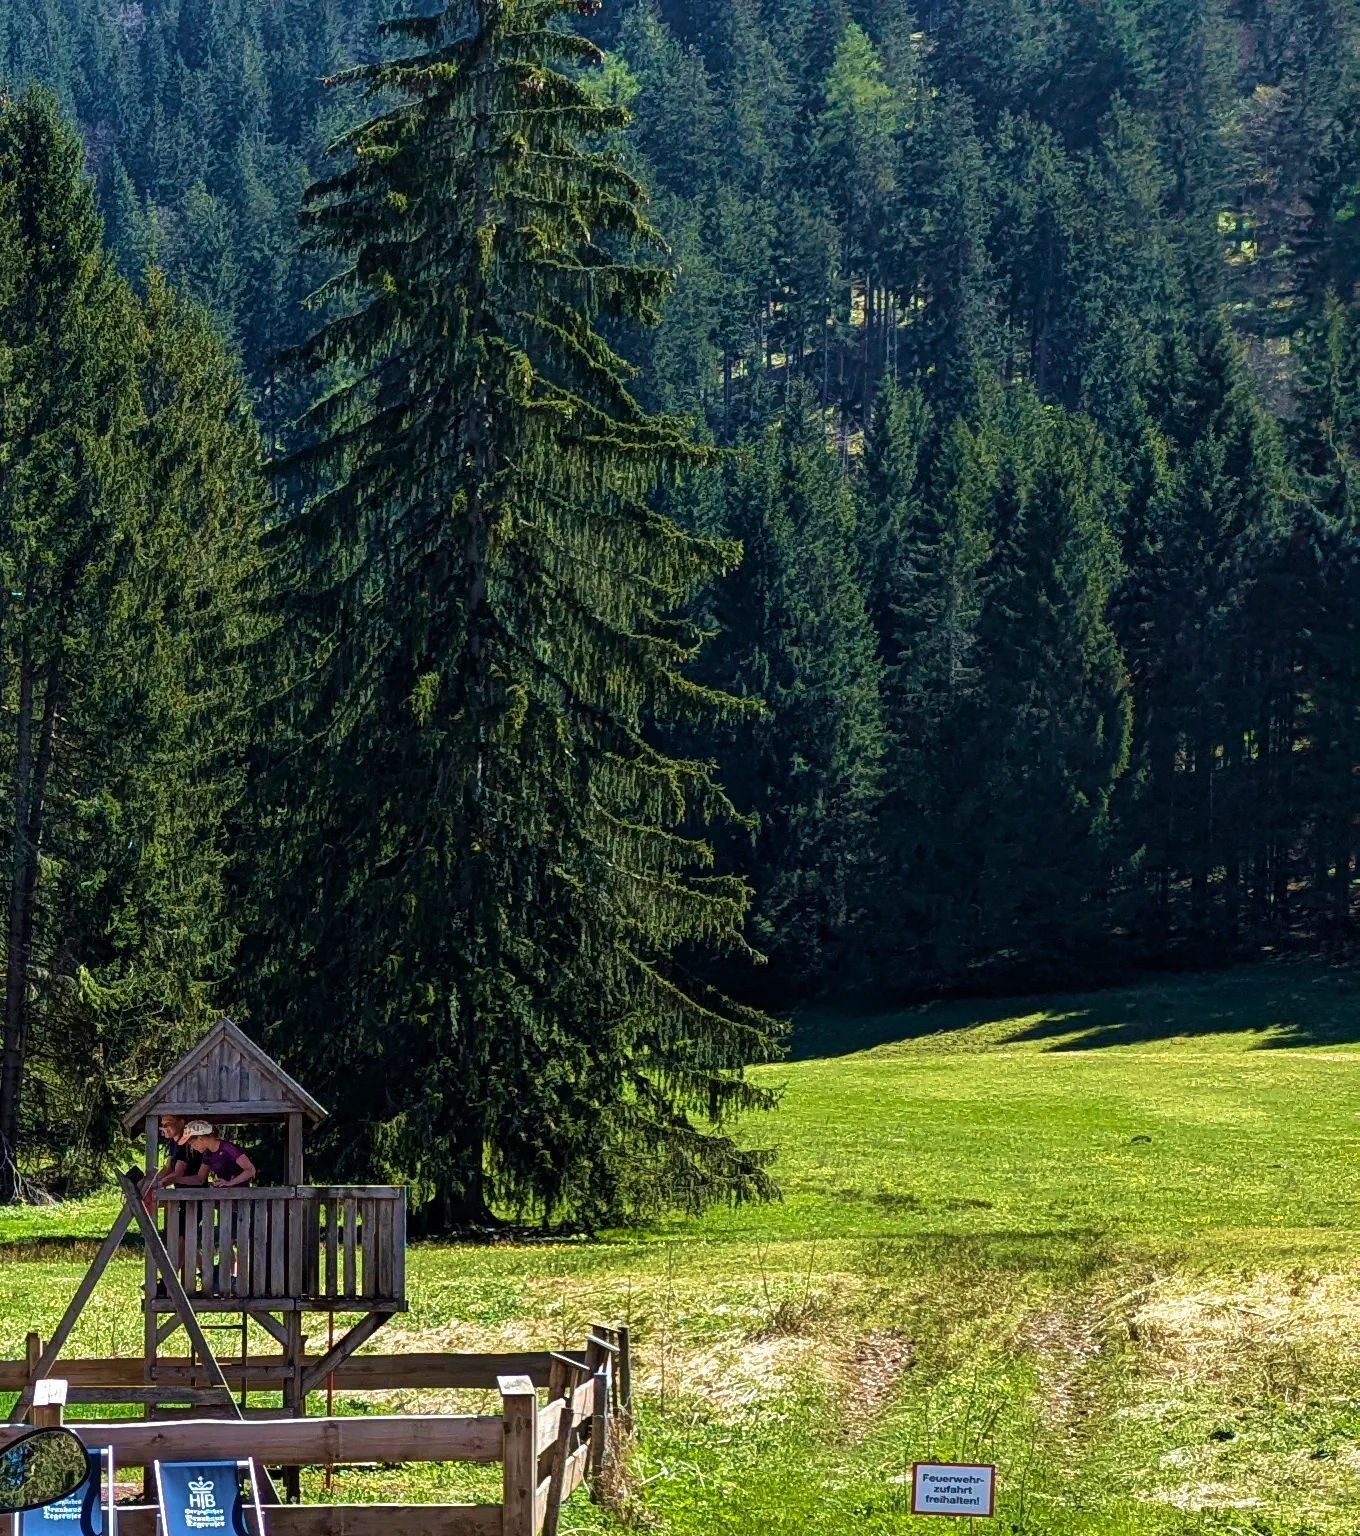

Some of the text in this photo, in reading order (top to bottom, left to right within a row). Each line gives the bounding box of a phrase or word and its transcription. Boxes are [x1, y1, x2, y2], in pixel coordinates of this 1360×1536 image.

[922, 1473, 985, 1484] Feuerwehr-
[933, 1485, 973, 1494] zufahrt
[189, 1490, 216, 1509] HTB
[925, 1494, 980, 1505] freihalten!
